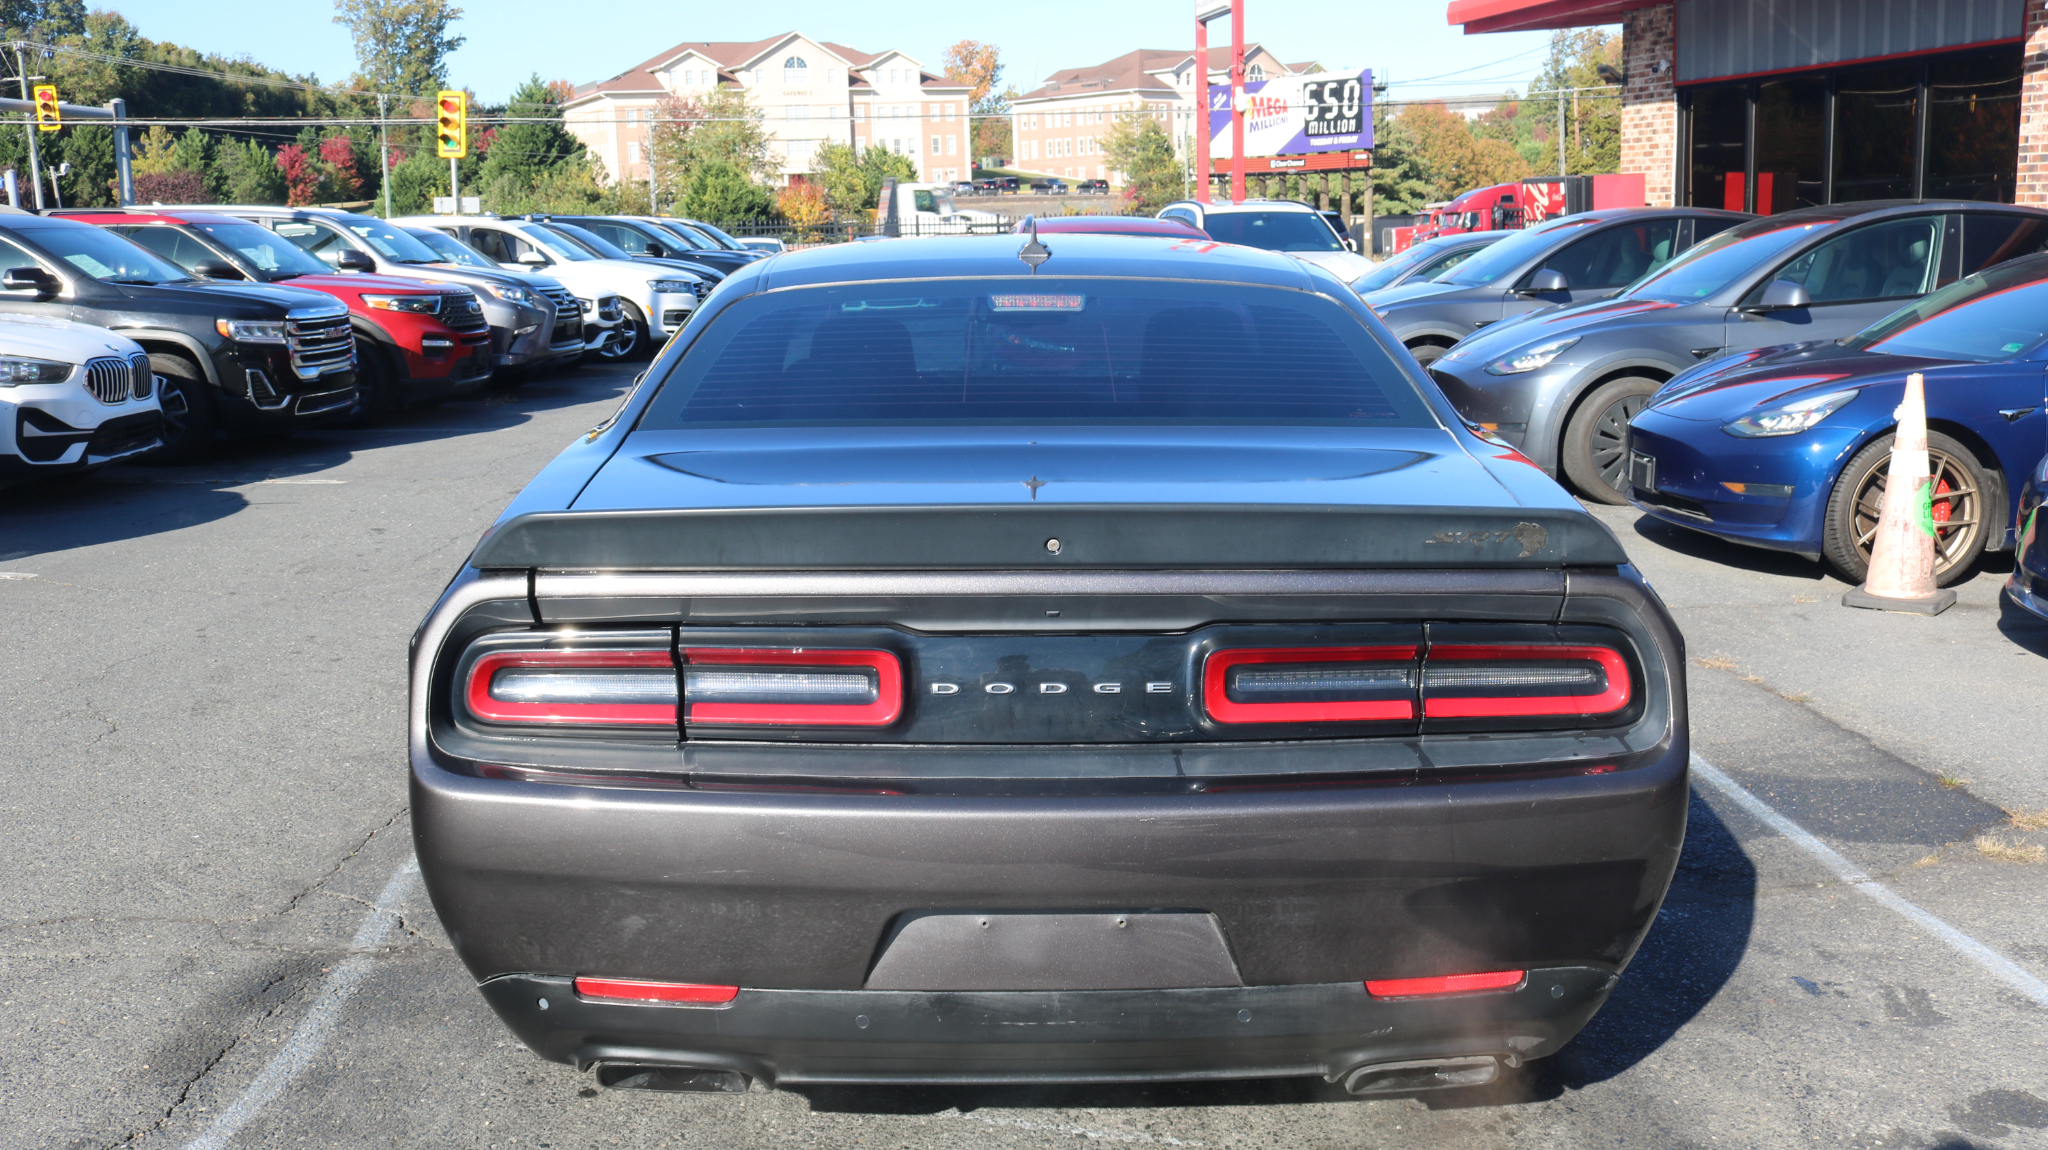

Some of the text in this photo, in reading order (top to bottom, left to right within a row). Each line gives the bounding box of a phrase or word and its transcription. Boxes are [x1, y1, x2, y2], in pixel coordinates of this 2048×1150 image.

[1251, 96, 1288, 119] MEGA
[1304, 79, 1360, 121] 650
[1249, 116, 1288, 133] MILLIONS
[1308, 119, 1356, 134] MILLION
[931, 682, 1173, 694] DODGE
